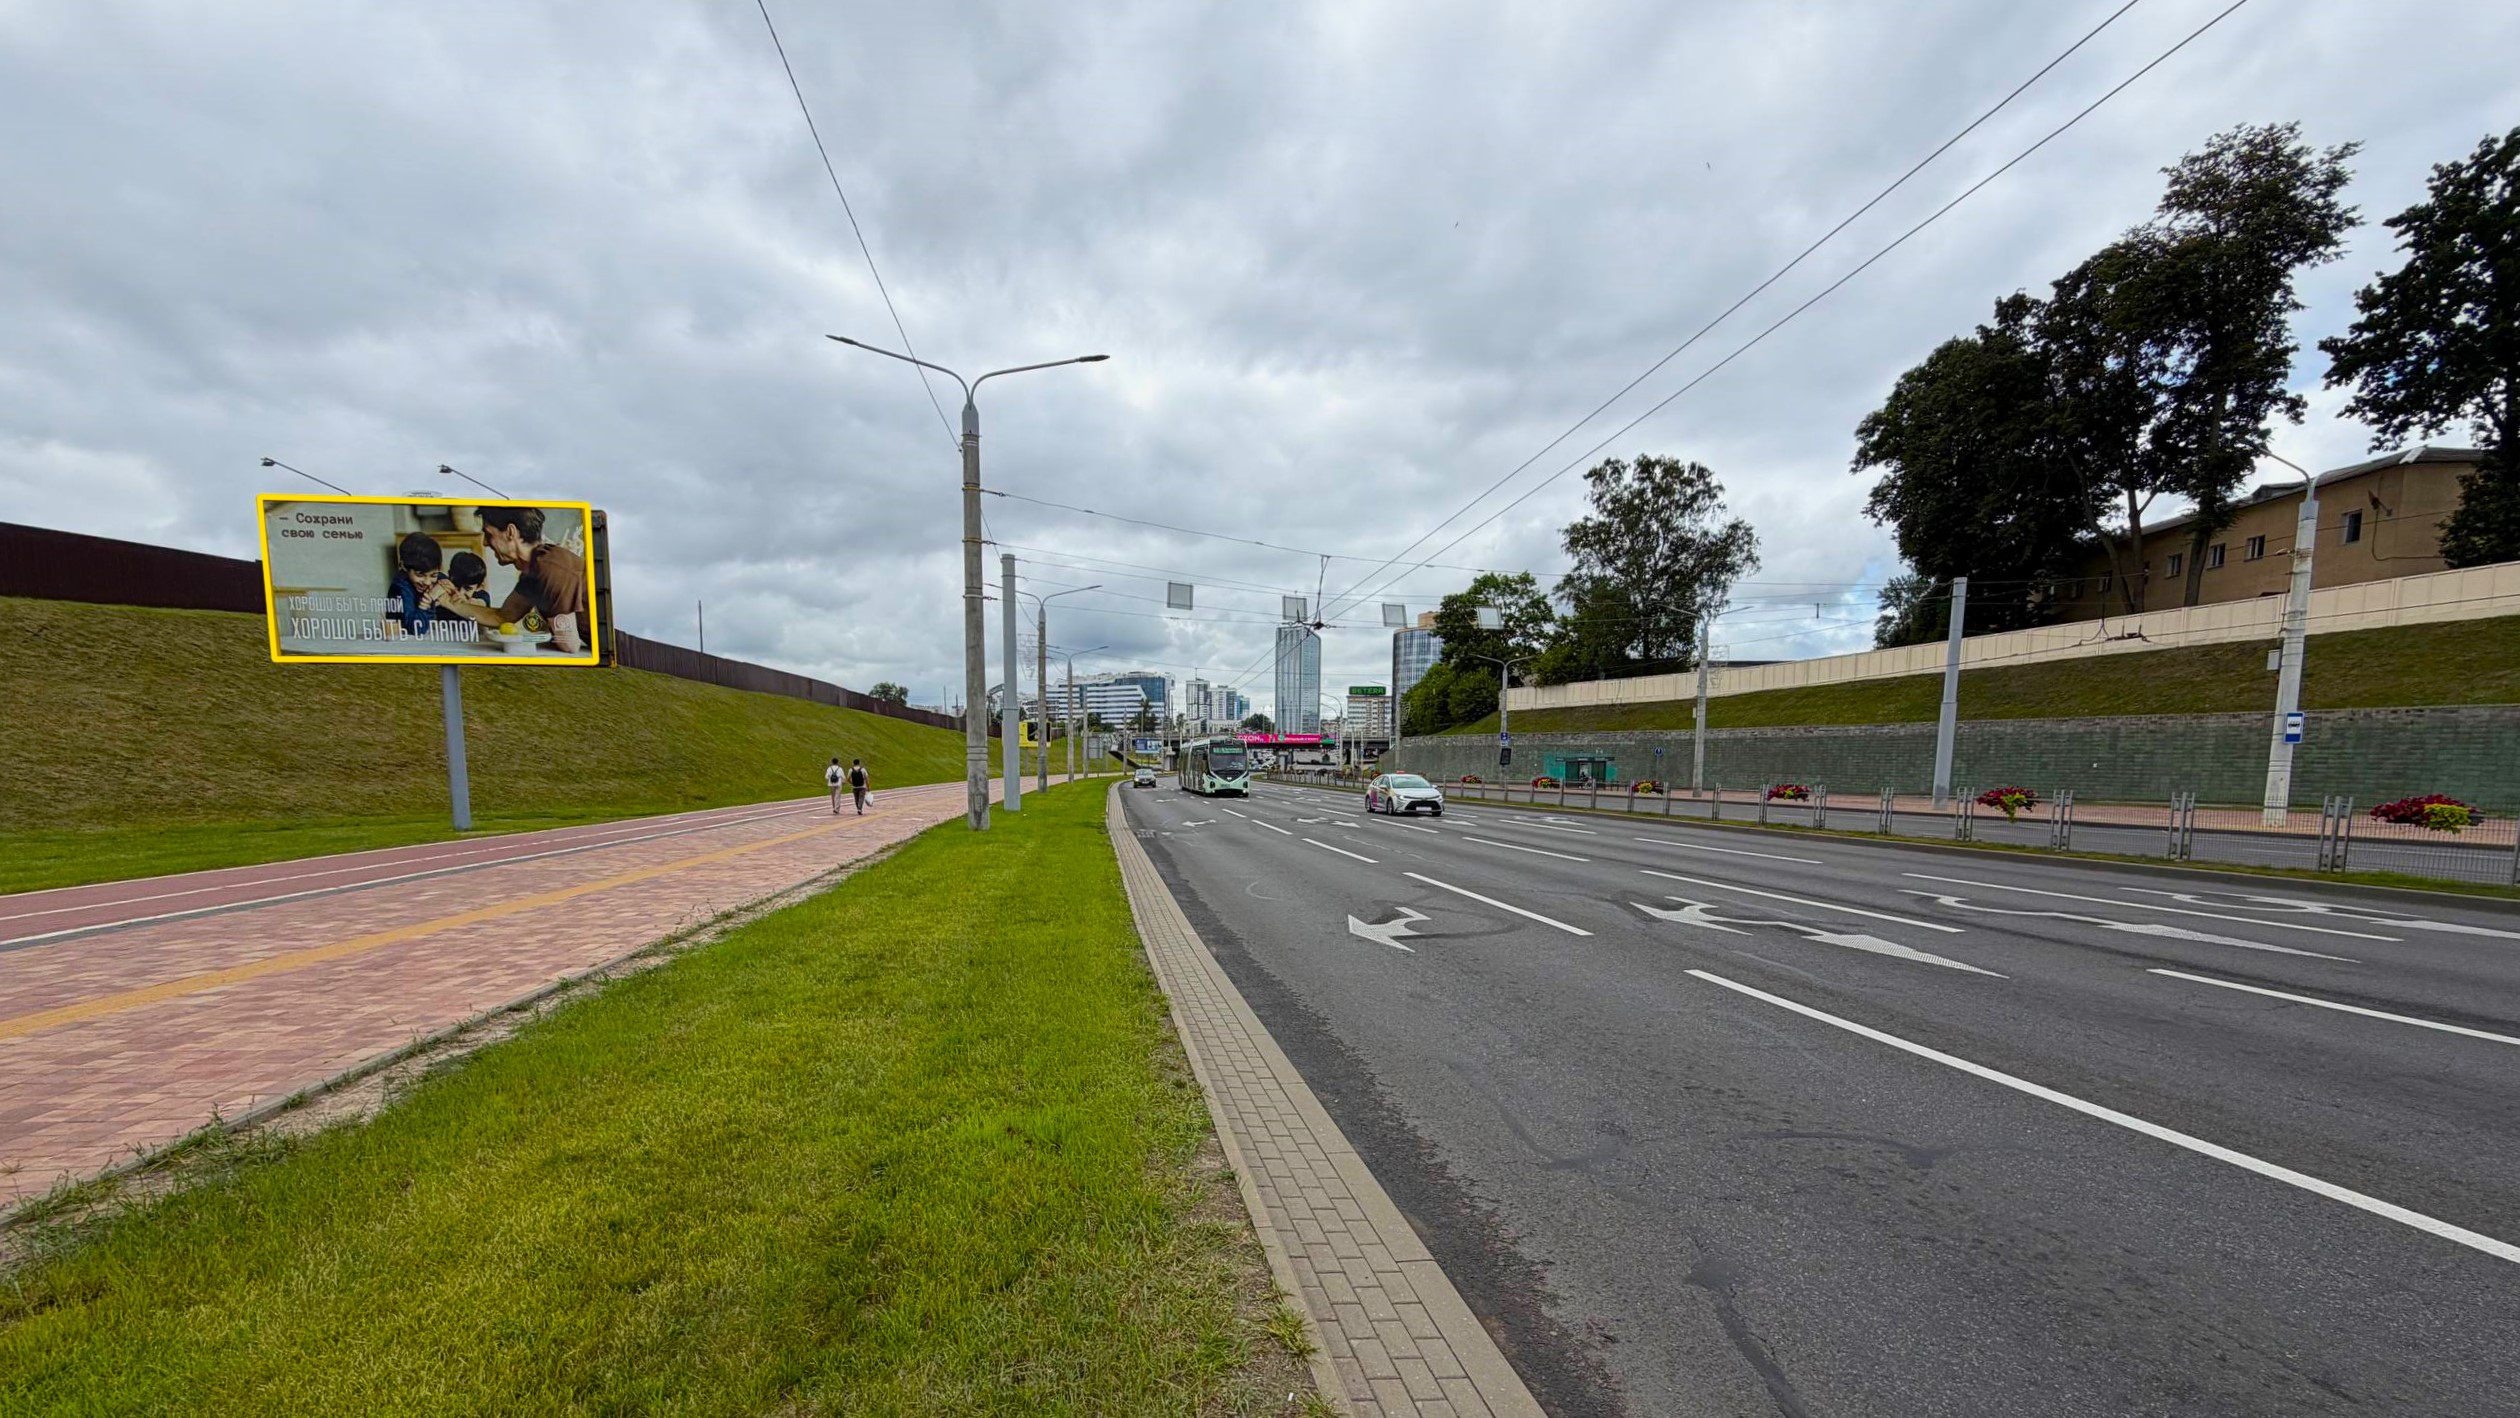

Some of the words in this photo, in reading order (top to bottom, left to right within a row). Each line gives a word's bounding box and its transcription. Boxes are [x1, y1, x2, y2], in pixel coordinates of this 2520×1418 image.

[296, 512, 354, 526] Сохрани
[281, 529, 315, 538] свою
[322, 530, 363, 539] семью
[288, 596, 332, 612] ХОРОШО
[336, 597, 367, 613] БЫТЬ
[370, 595, 405, 613] ПАПОЙ
[291, 617, 357, 640] ХОРОШО
[362, 618, 408, 641] БЫТЬ
[413, 620, 424, 641] С
[429, 616, 480, 642] ПАПОЙ
